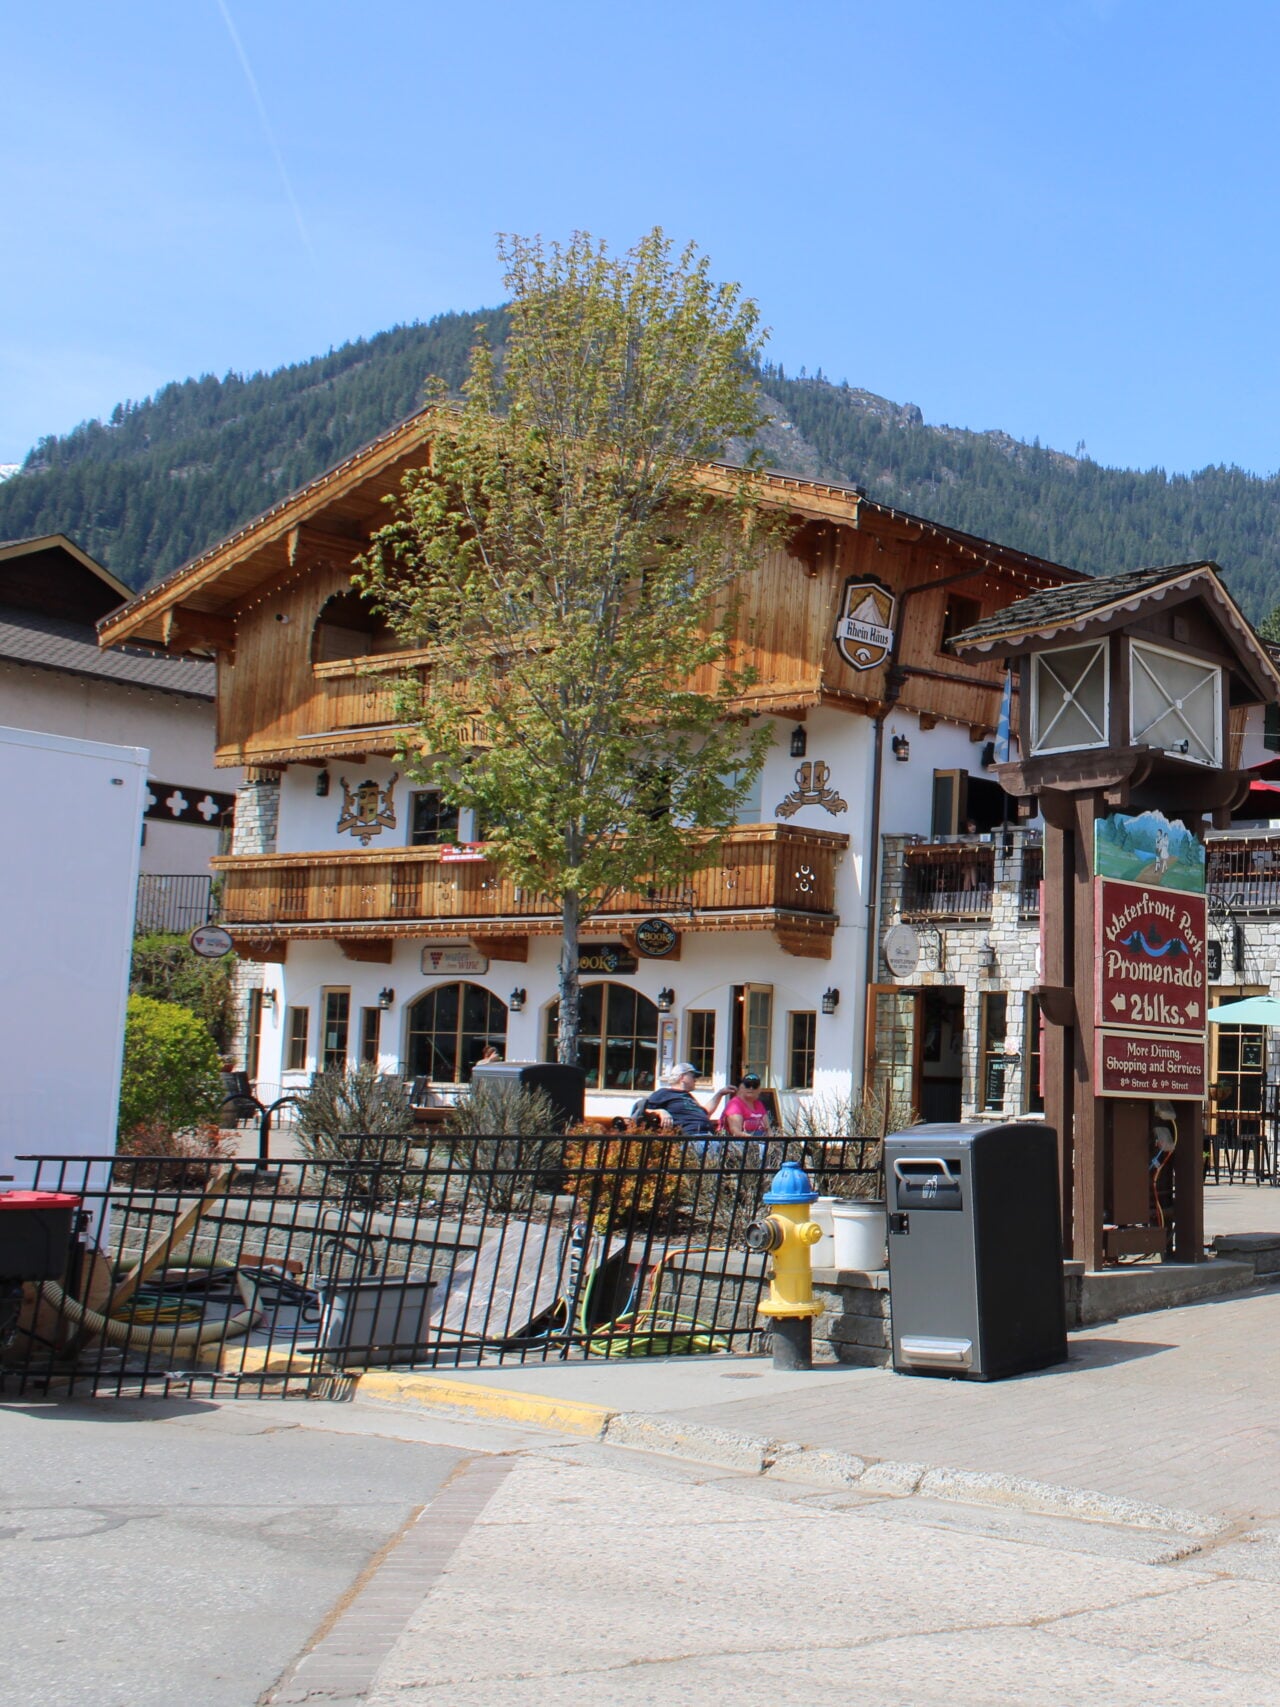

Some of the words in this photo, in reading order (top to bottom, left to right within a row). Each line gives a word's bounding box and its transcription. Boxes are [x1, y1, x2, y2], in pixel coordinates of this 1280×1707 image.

[846, 620, 869, 640] Rhein
[1105, 892, 1176, 942] Waterfront
[1179, 910, 1203, 958] Park
[578, 955, 614, 973] OOK
[1104, 949, 1203, 988] Promenade
[1127, 1042, 1149, 1058] More
[1106, 1055, 1147, 1075] Shopping
[1149, 1060, 1165, 1073] and
[1167, 1060, 1201, 1075] Services
[1120, 1077, 1130, 1088] 8th
[1131, 1078, 1150, 1088] Street
[1151, 1078, 1158, 1089] &
[1160, 1079, 1170, 1089] 9th
[1171, 1080, 1189, 1090] Street
